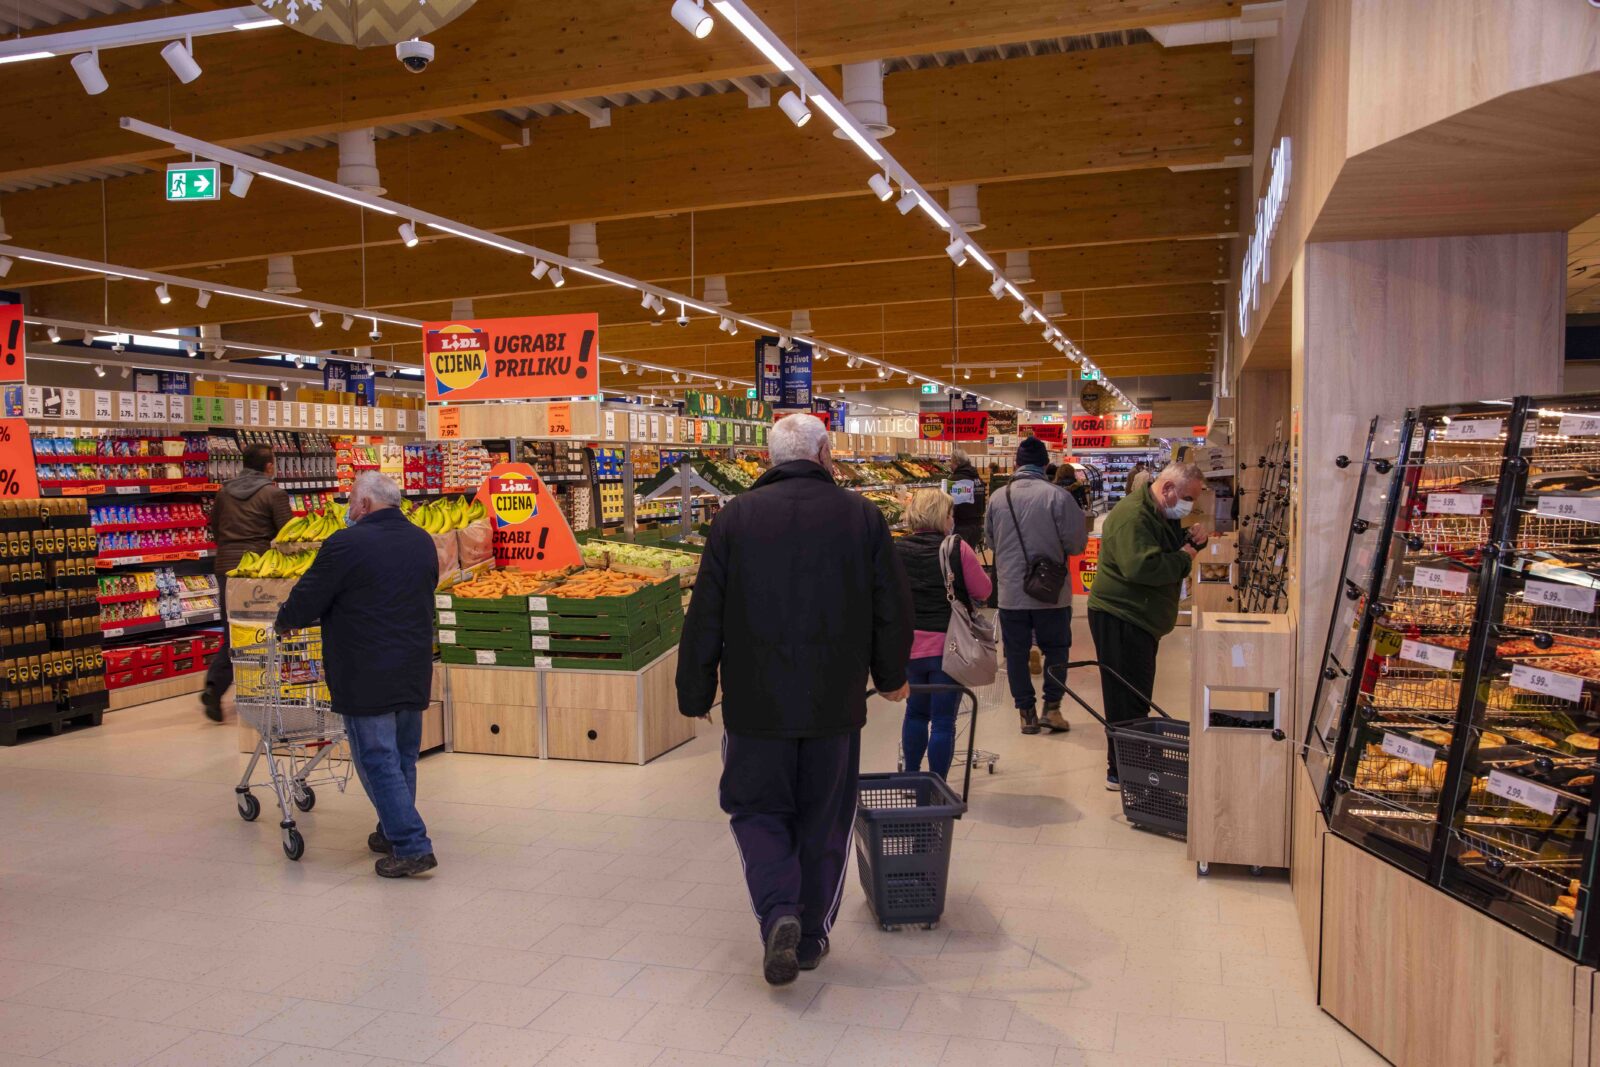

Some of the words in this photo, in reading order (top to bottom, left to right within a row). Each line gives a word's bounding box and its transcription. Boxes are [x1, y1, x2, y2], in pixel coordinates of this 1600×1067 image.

[494, 333, 567, 354] UGRABI
[435, 353, 482, 375] CIJENA
[495, 356, 572, 378] PRILIKU
[550, 424, 565, 433] 3.79
[1072, 418, 1119, 431] UGRABI
[1122, 418, 1152, 430] PRIL
[441, 429, 455, 437] 7.99
[496, 495, 533, 511] CIJENA
[1558, 504, 1573, 514] 9.99
[492, 531, 531, 544] GRABI
[492, 547, 535, 560] RILIKU
[1543, 590, 1558, 601] 6.99
[1530, 675, 1545, 687] 5.99
[1506, 785, 1521, 798] 2.99
